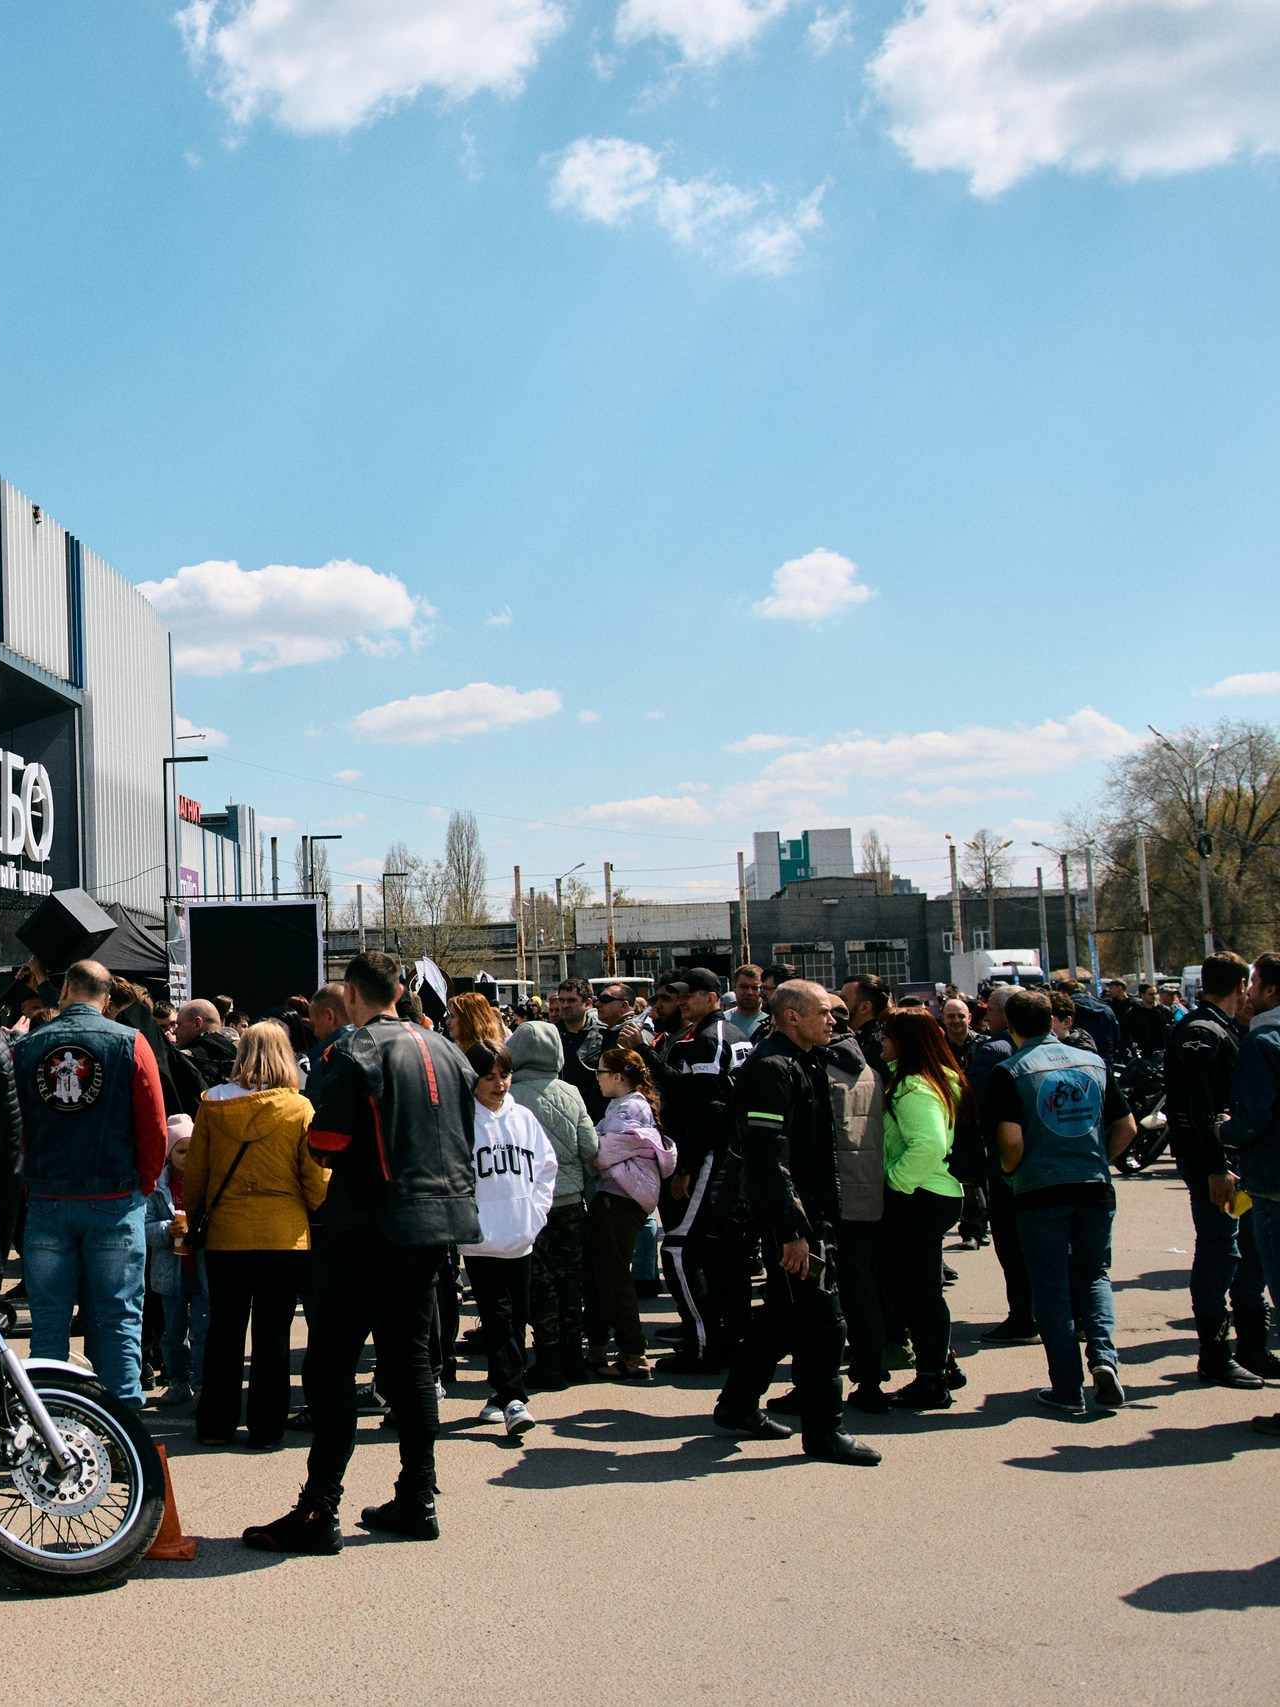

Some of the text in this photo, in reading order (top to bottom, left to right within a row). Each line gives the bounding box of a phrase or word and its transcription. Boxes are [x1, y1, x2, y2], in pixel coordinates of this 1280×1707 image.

[178, 794, 201, 823] АГНИТ
[19, 869, 53, 896] ЦЕНТР
[36, 1062, 103, 1104] FREE RIDER
[471, 1144, 535, 1183] COUT
